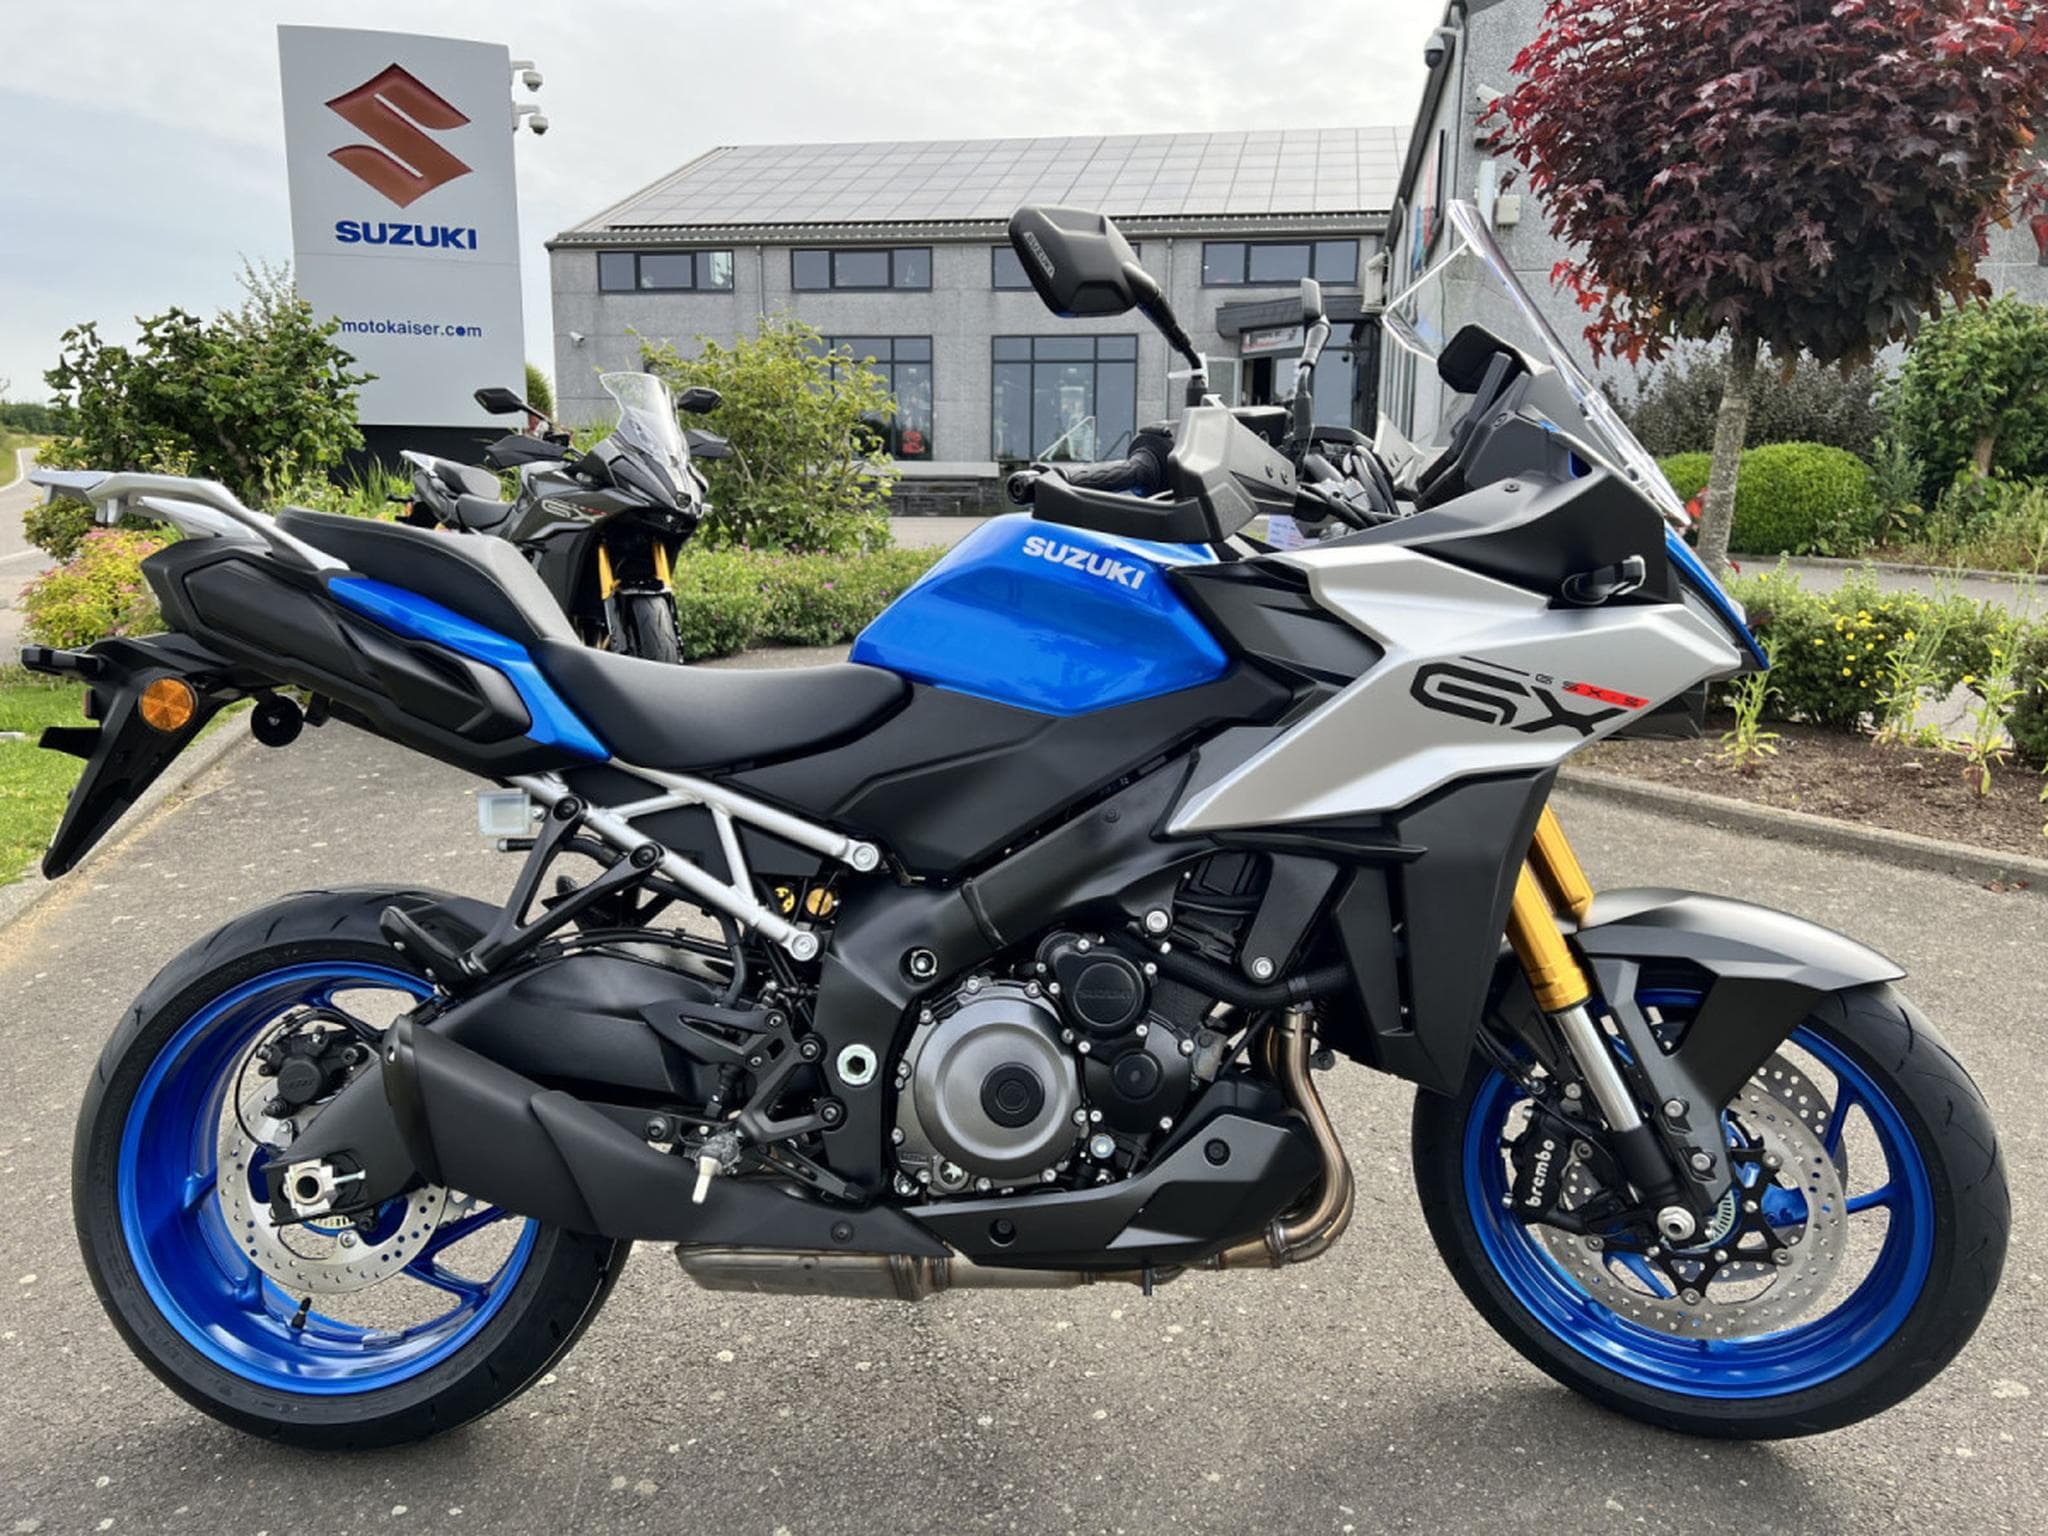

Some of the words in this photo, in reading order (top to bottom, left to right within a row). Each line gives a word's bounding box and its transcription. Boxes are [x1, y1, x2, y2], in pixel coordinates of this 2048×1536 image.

[335, 220, 477, 250] SUZUKI
[342, 320, 482, 337] motokaiser.com
[1022, 536, 1146, 590] SUZUKI
[1525, 1139, 1556, 1208] brembo
